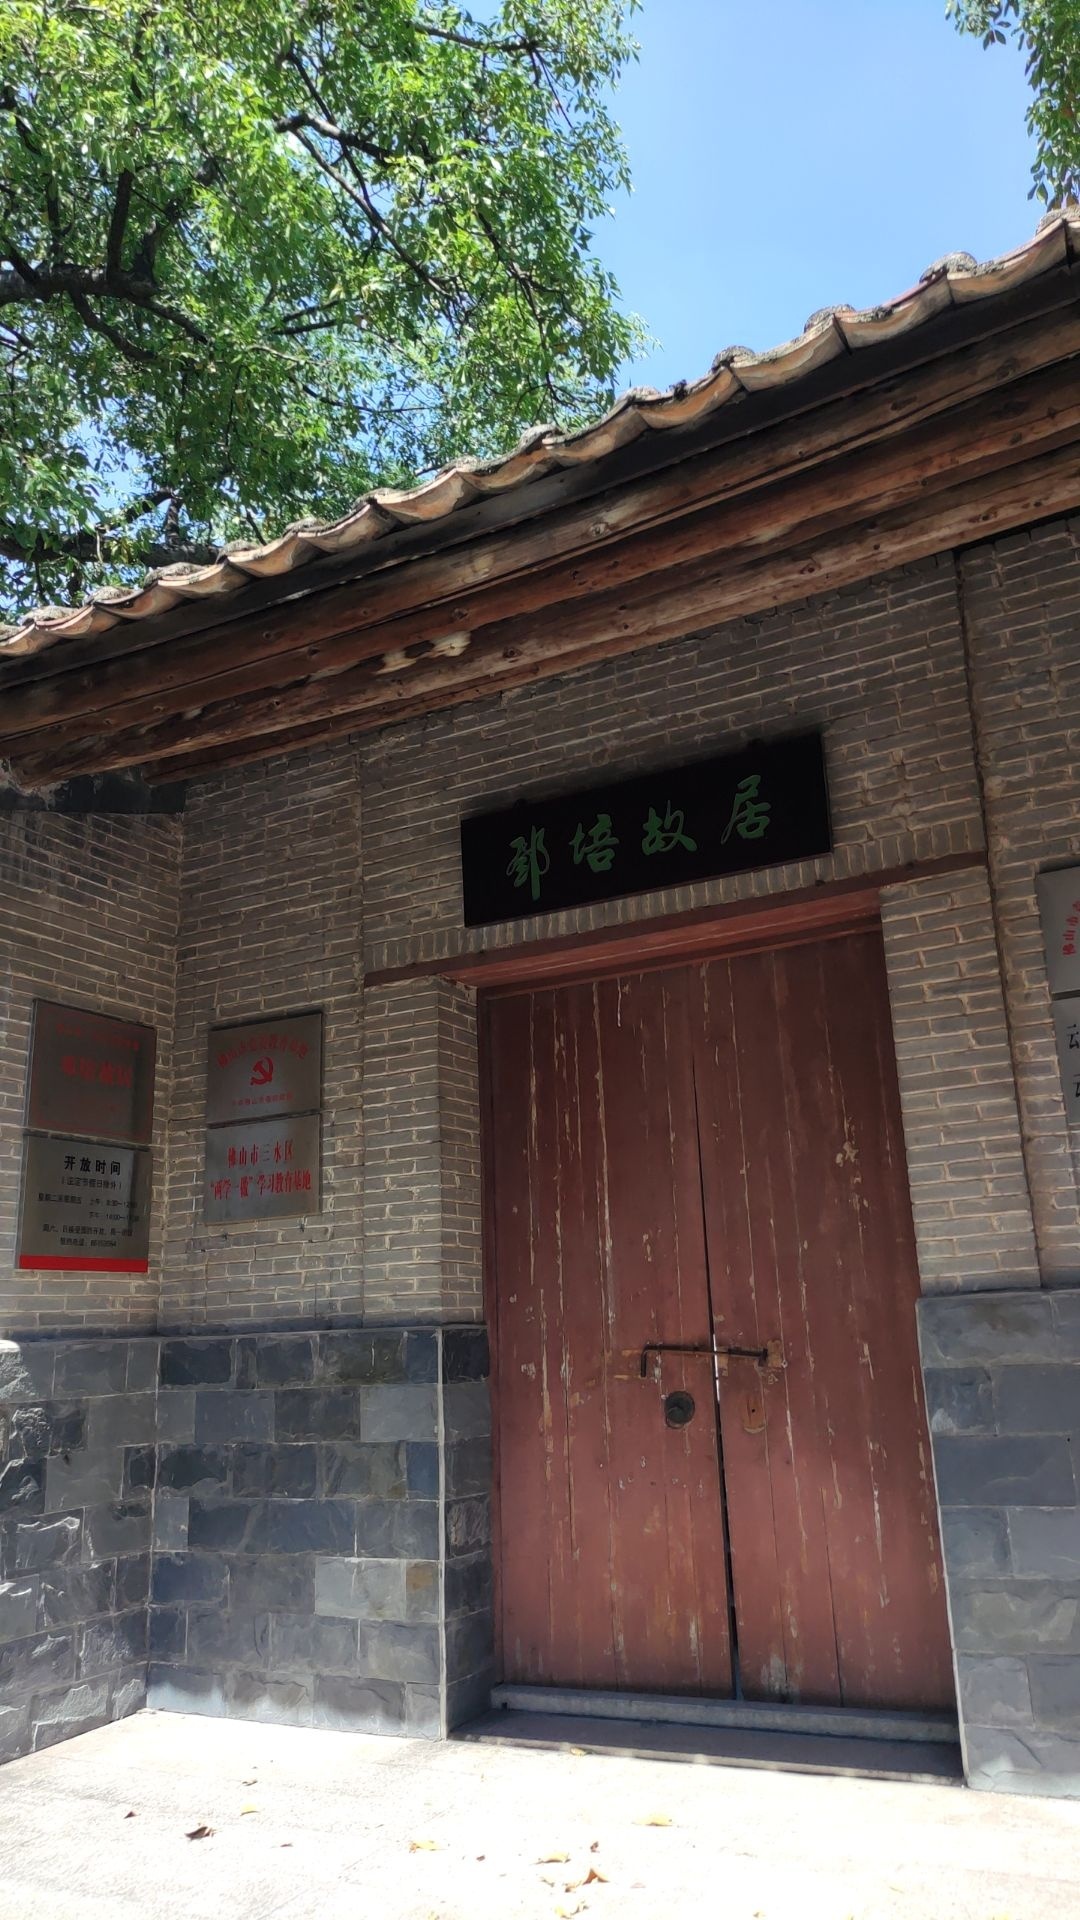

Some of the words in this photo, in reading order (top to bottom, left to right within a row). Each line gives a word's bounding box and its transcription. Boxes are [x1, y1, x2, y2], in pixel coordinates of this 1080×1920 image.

[64, 1155, 121, 1176] 开放时间
[228, 1139, 294, 1168] 佛山市三水区
